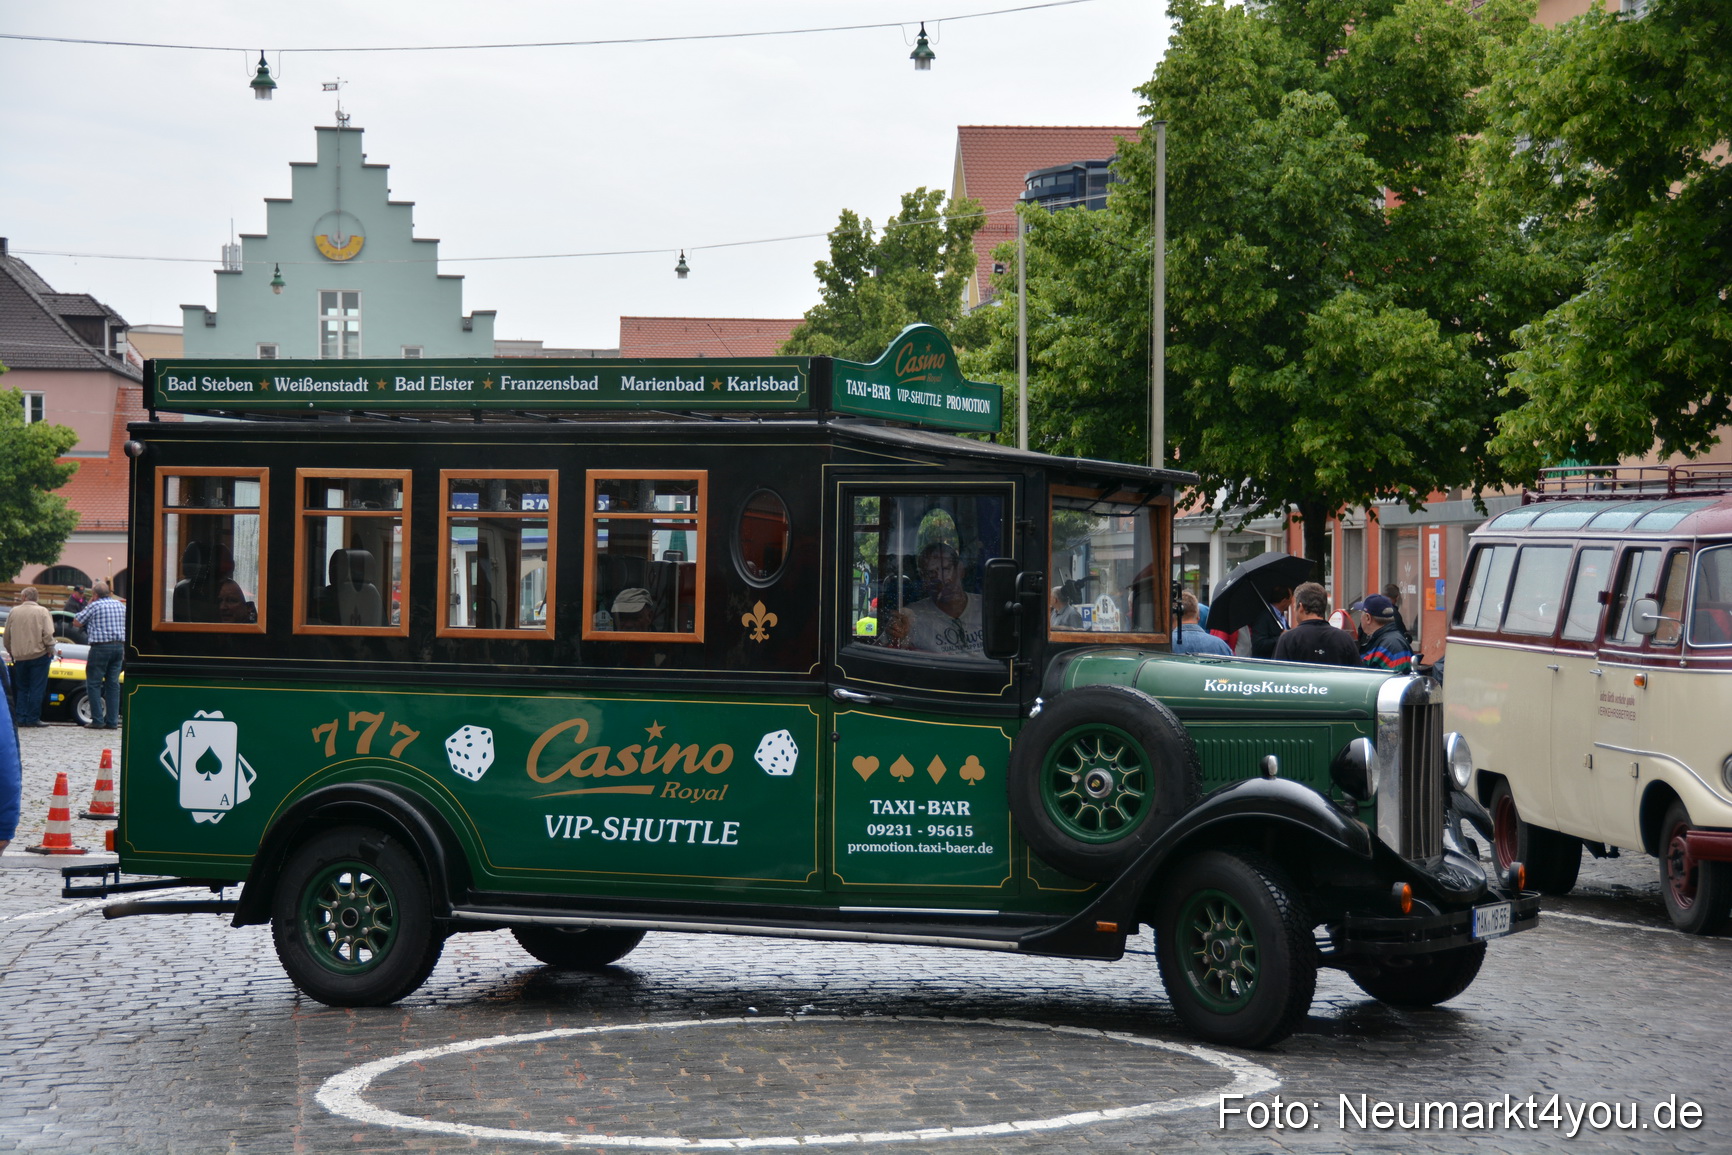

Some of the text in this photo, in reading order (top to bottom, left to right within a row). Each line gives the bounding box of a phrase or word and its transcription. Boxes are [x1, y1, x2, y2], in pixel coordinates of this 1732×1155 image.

[895, 342, 946, 377] Casino
[167, 376, 799, 392] Bad Steben Weißenstadt Bad Elster Franzensbad Marienbad Karlsbad
[846, 379, 990, 414] TAXI-BÄR VIP-SHUTTLE PROMOTION
[935, 628, 984, 646] s.Olive
[526, 718, 734, 784] Casino
[660, 781, 729, 804] Royal
[870, 800, 971, 816] TAXI-BÄR
[545, 814, 740, 845] VIP-SHUTTLE
[867, 824, 912, 836] 09231
[927, 825, 974, 837] 95615
[848, 841, 994, 854] promotion.taxi-baer.de
